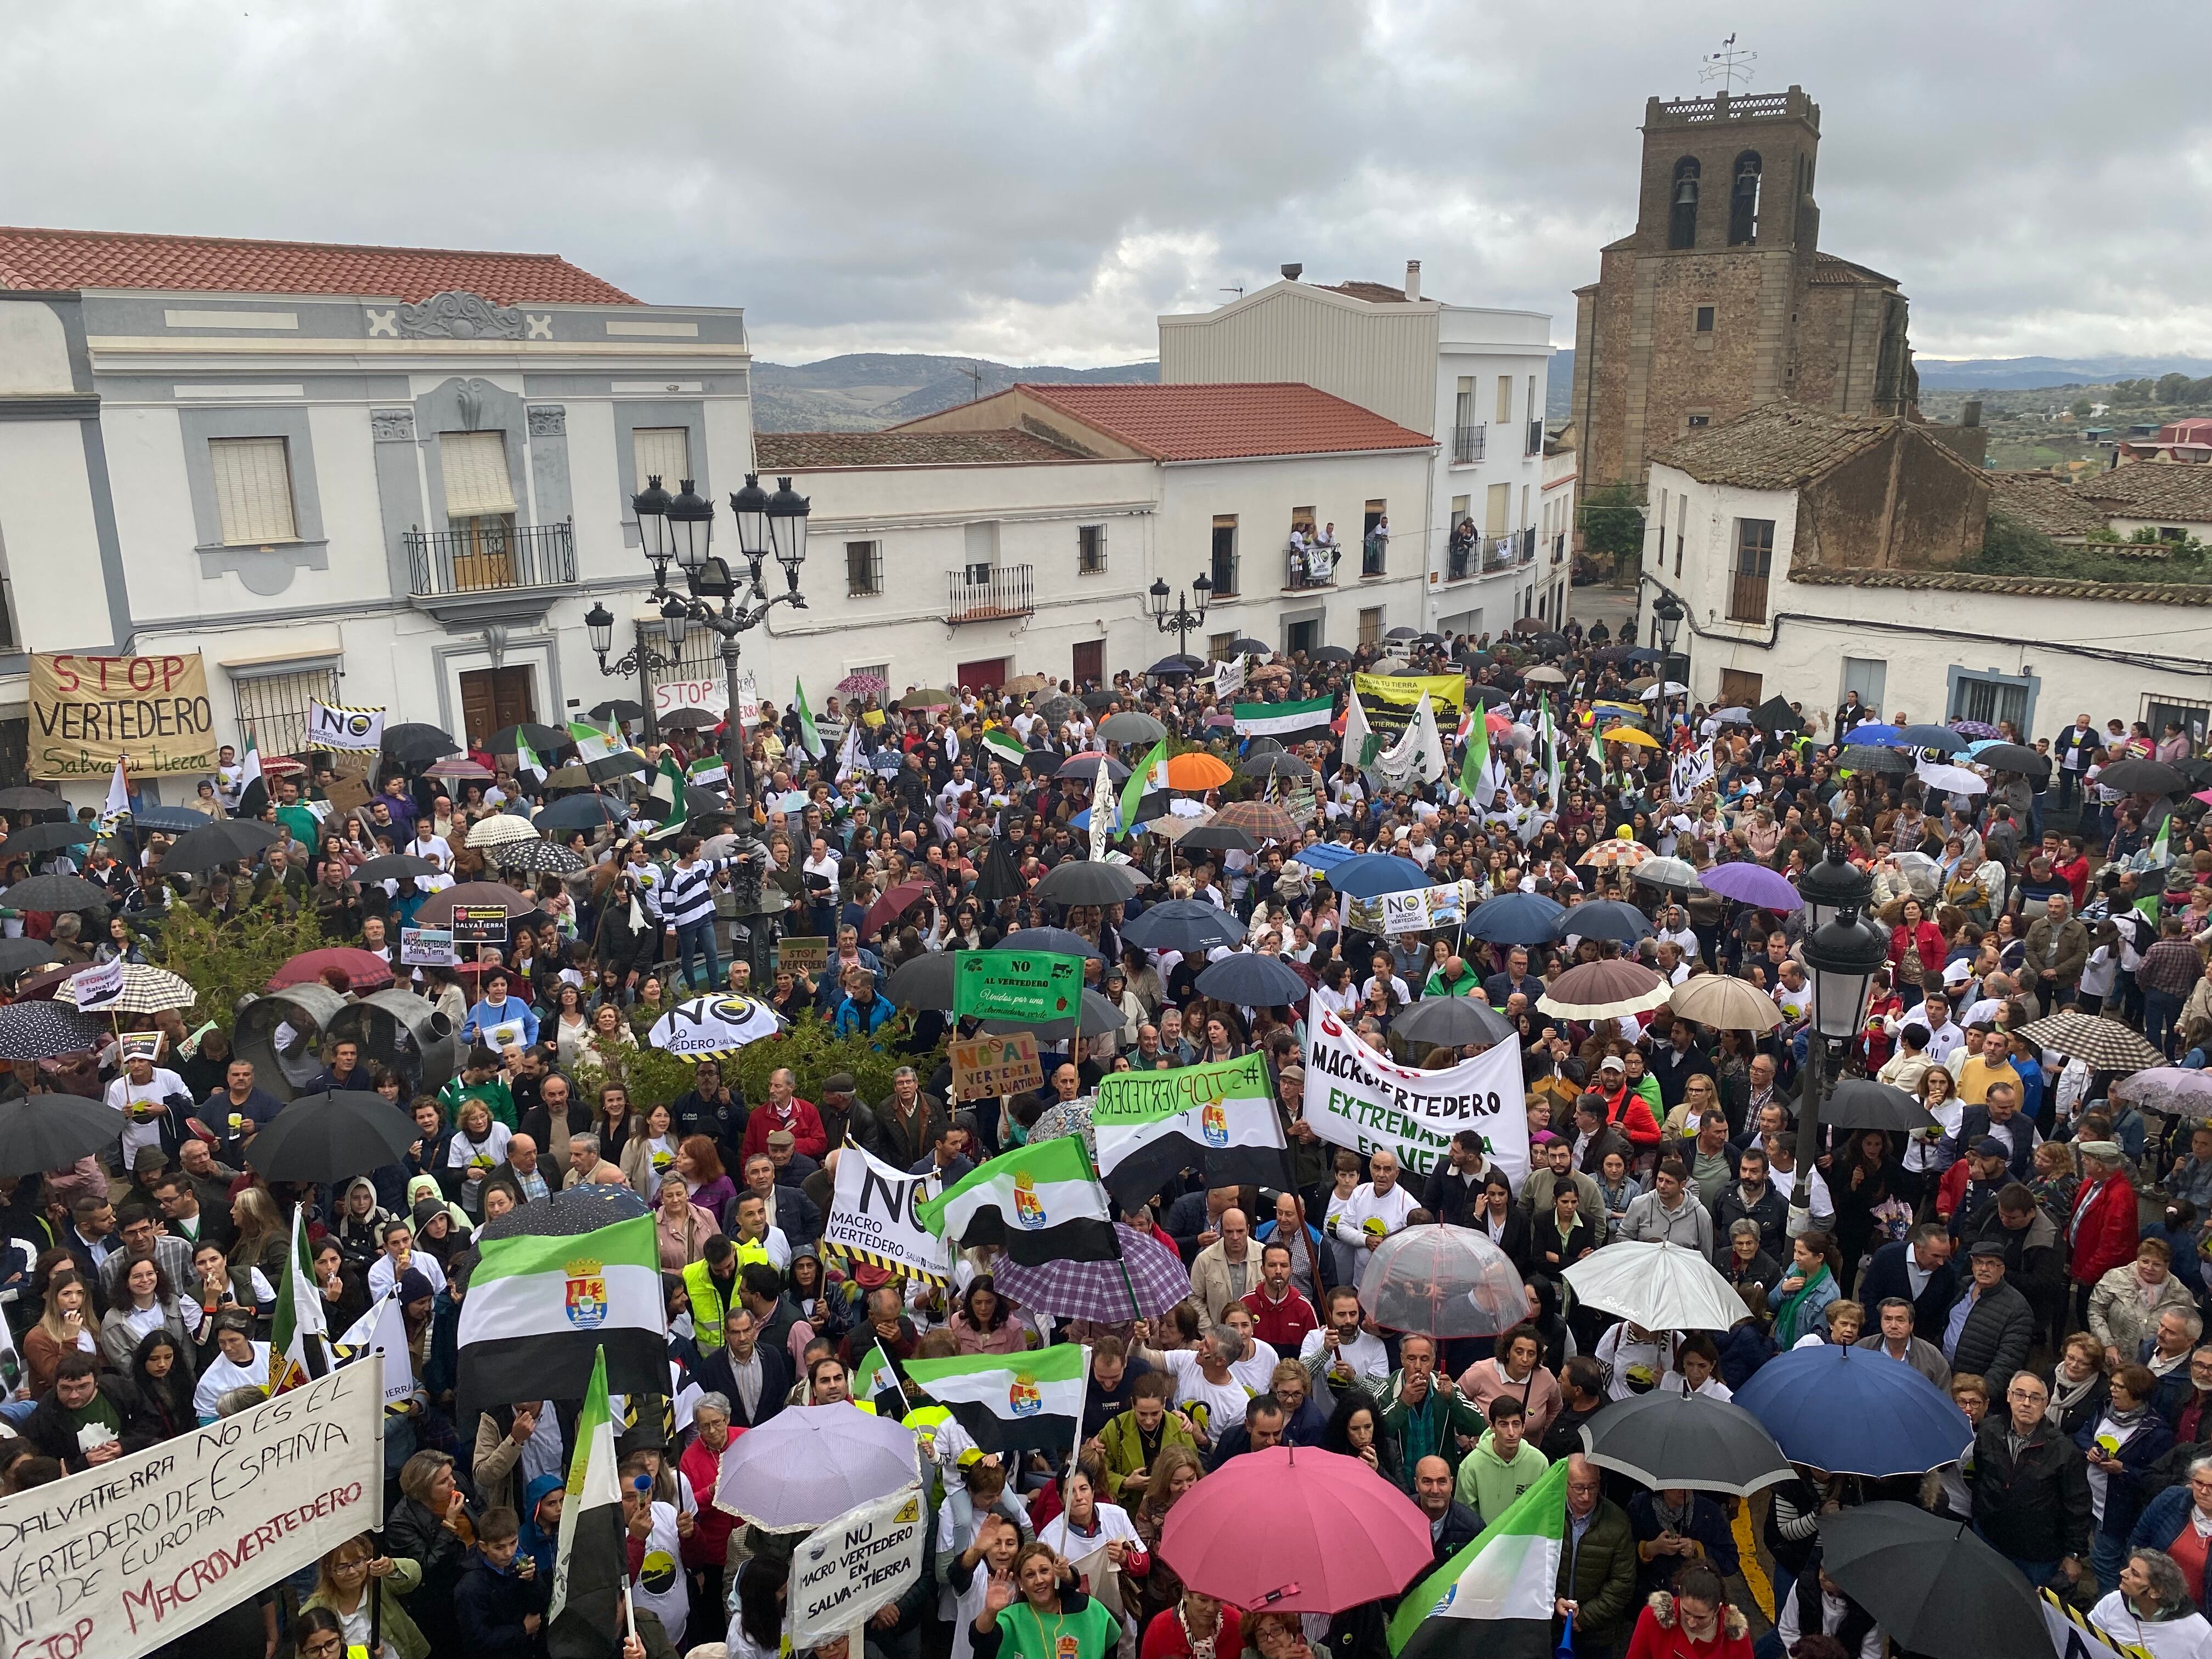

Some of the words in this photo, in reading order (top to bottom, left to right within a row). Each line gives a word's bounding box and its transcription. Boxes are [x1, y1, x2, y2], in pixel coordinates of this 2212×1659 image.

[1311, 550, 1329, 564] NO
[53, 655, 184, 692] STOP
[1221, 672, 1235, 682] MACRO
[1359, 677, 1380, 685] SALVA
[656, 681, 713, 709] STOP
[33, 696, 212, 740] VERTEDERO
[320, 708, 373, 737] NO
[307, 734, 347, 747] VERTEDERO
[308, 728, 333, 738] MACRO
[816, 727, 841, 736] adenex
[43, 747, 114, 774] Salva
[1388, 895, 1419, 913] NO
[1390, 916, 1422, 924] VERTEDERO
[403, 938, 452, 949] MACROVERTEDERO
[406, 932, 421, 940] STOP
[789, 949, 817, 958] STOP
[780, 960, 826, 970] VERTEDERO
[1011, 961, 1031, 972] NO
[78, 976, 101, 986] STOP
[998, 978, 1048, 988] VERTEDERO
[980, 989, 1013, 1003] Unidos
[1012, 996, 1028, 1005] por
[668, 998, 755, 1035] NO
[973, 1002, 1026, 1017] Extremadura
[1027, 1010, 1047, 1019] verde
[182, 1038, 194, 1054] STOP
[956, 1046, 993, 1069] NO
[1002, 1040, 1036, 1063] AL
[965, 1063, 1038, 1085] VERTEDERO
[964, 1087, 981, 1099] EN
[860, 1166, 929, 1234] NO
[831, 1211, 882, 1233] MACRO
[831, 1226, 904, 1256] VERTEDERO
[905, 1251, 921, 1262] SALVA
[1603, 1295, 1640, 1317] Solano
[197, 1422, 241, 1460] NO
[253, 1401, 292, 1435] ES
[307, 1376, 353, 1413] EL
[166, 1477, 207, 1525] DE
[211, 1421, 349, 1502] ESPAÑA
[845, 1520, 872, 1550] NO
[122, 1481, 363, 1635] MACROVERTEDERO
[799, 1560, 836, 1590] MACRO
[839, 1526, 913, 1568] VERTEDERO
[0, 1600, 33, 1645] NI
[56, 1568, 103, 1616] DE
[122, 1505, 224, 1575] EUROPA
[849, 1560, 869, 1580] EN
[807, 1585, 851, 1620] SALVA
[861, 1556, 911, 1589] TIERRA
